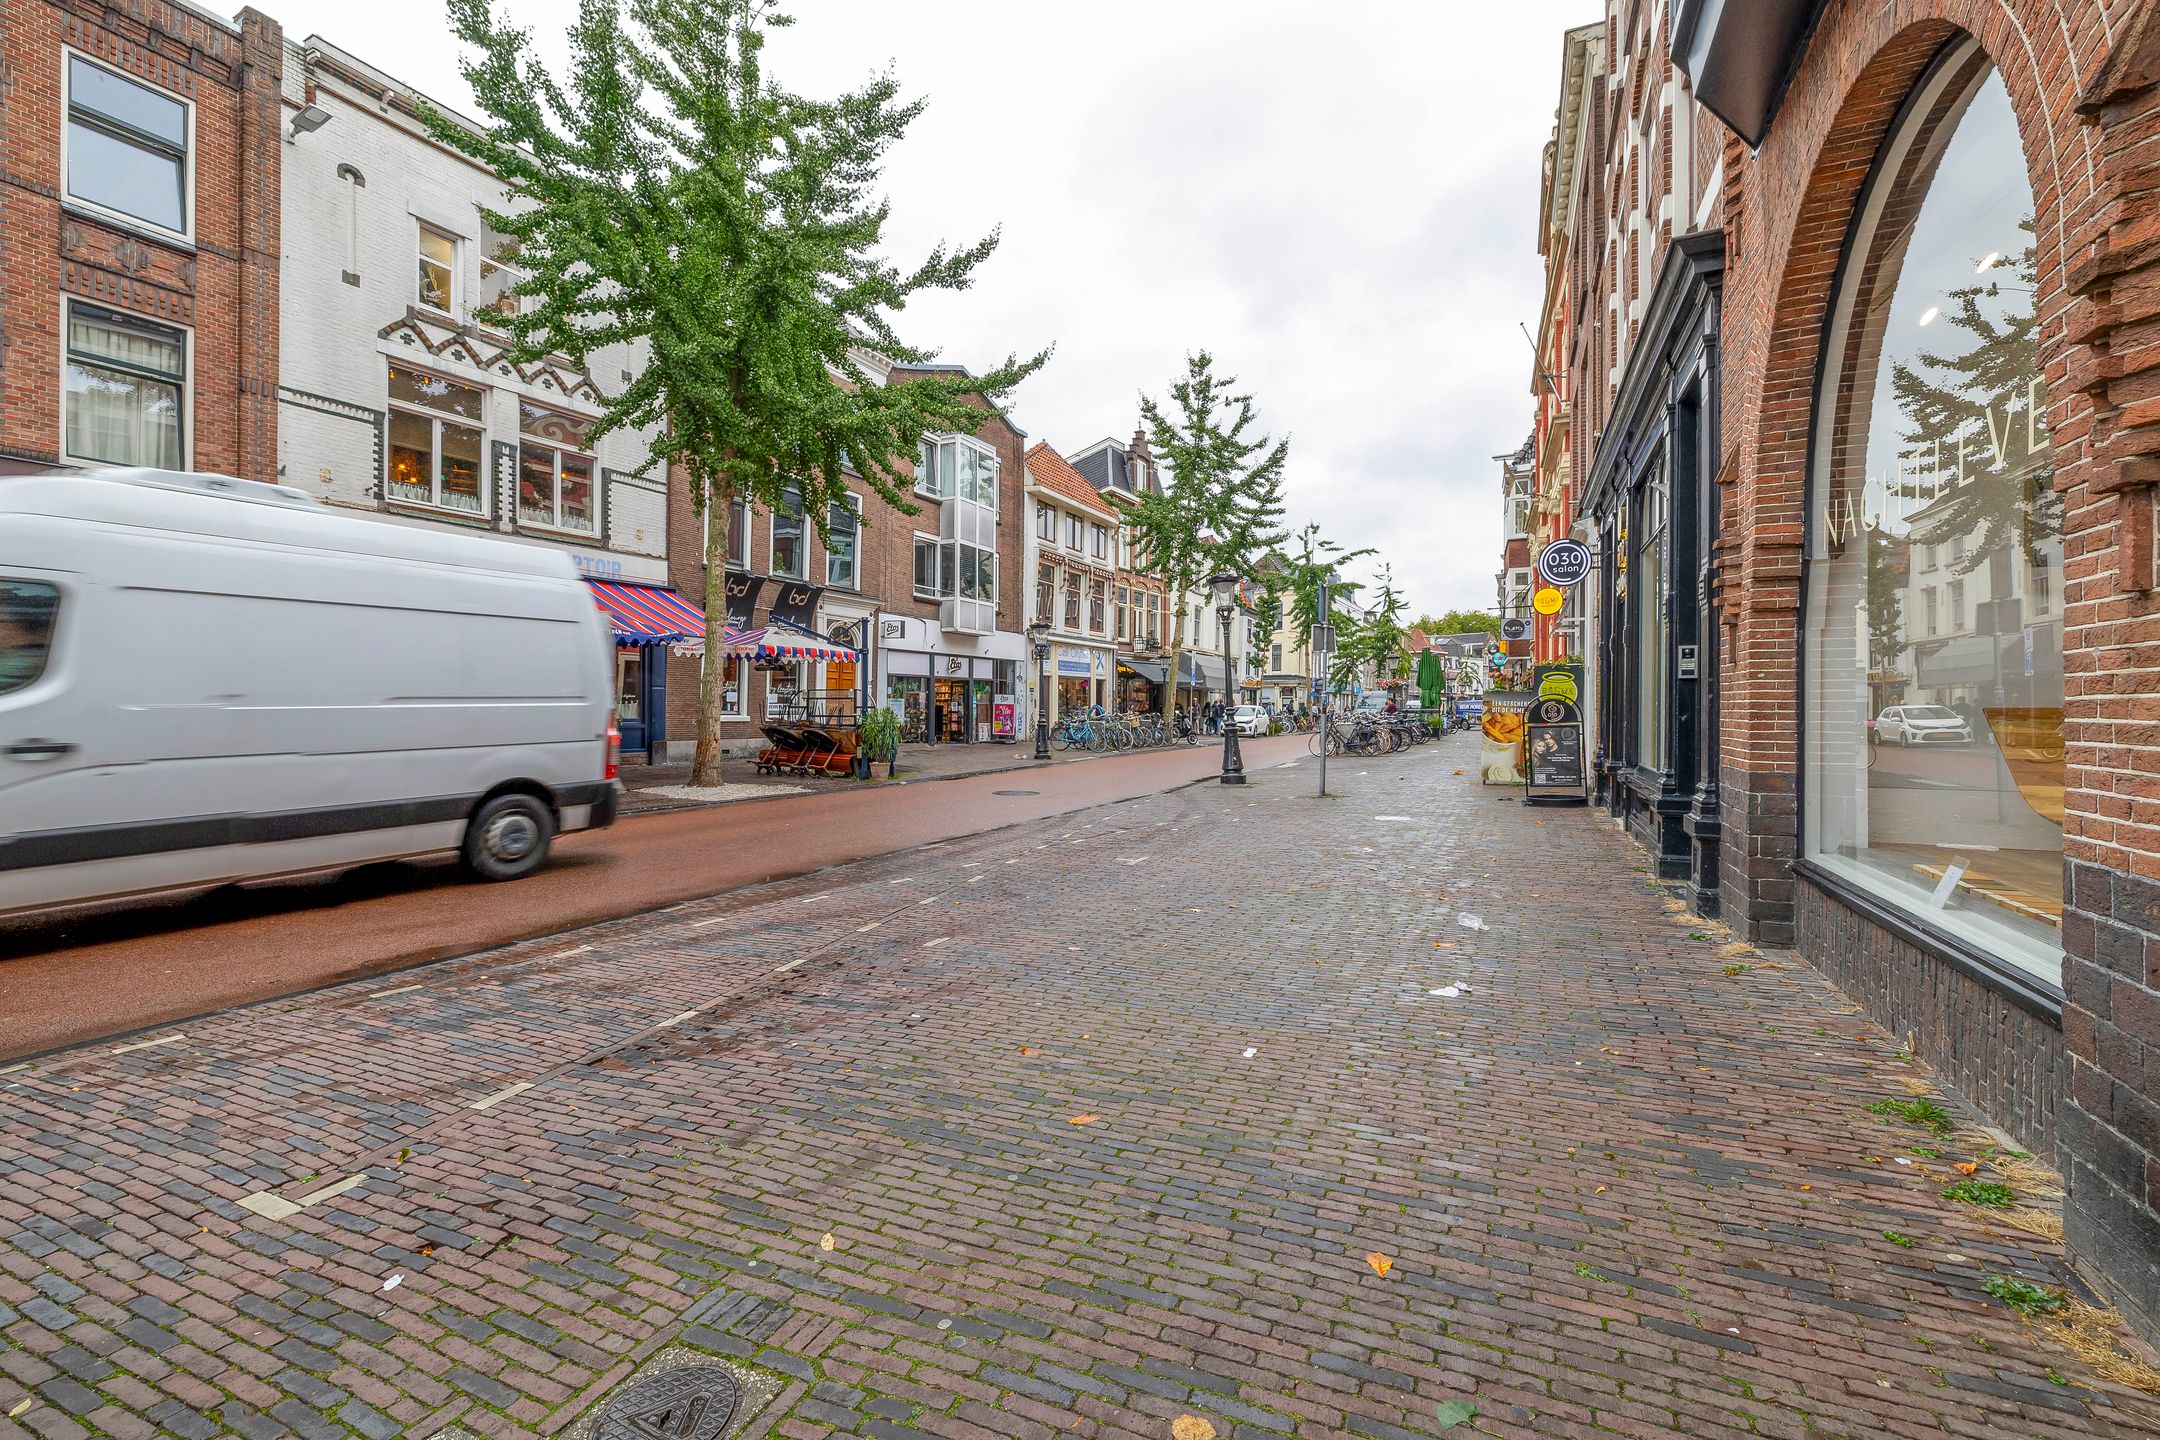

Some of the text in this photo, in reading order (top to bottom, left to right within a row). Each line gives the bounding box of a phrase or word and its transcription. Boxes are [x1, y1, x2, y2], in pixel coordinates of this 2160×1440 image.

[1823, 374, 2050, 551] NACHTLEVE
[1549, 551, 1582, 566] 030
[1552, 565, 1579, 574] salon
[886, 623, 900, 635] Etos
[948, 656, 962, 673] Etos
